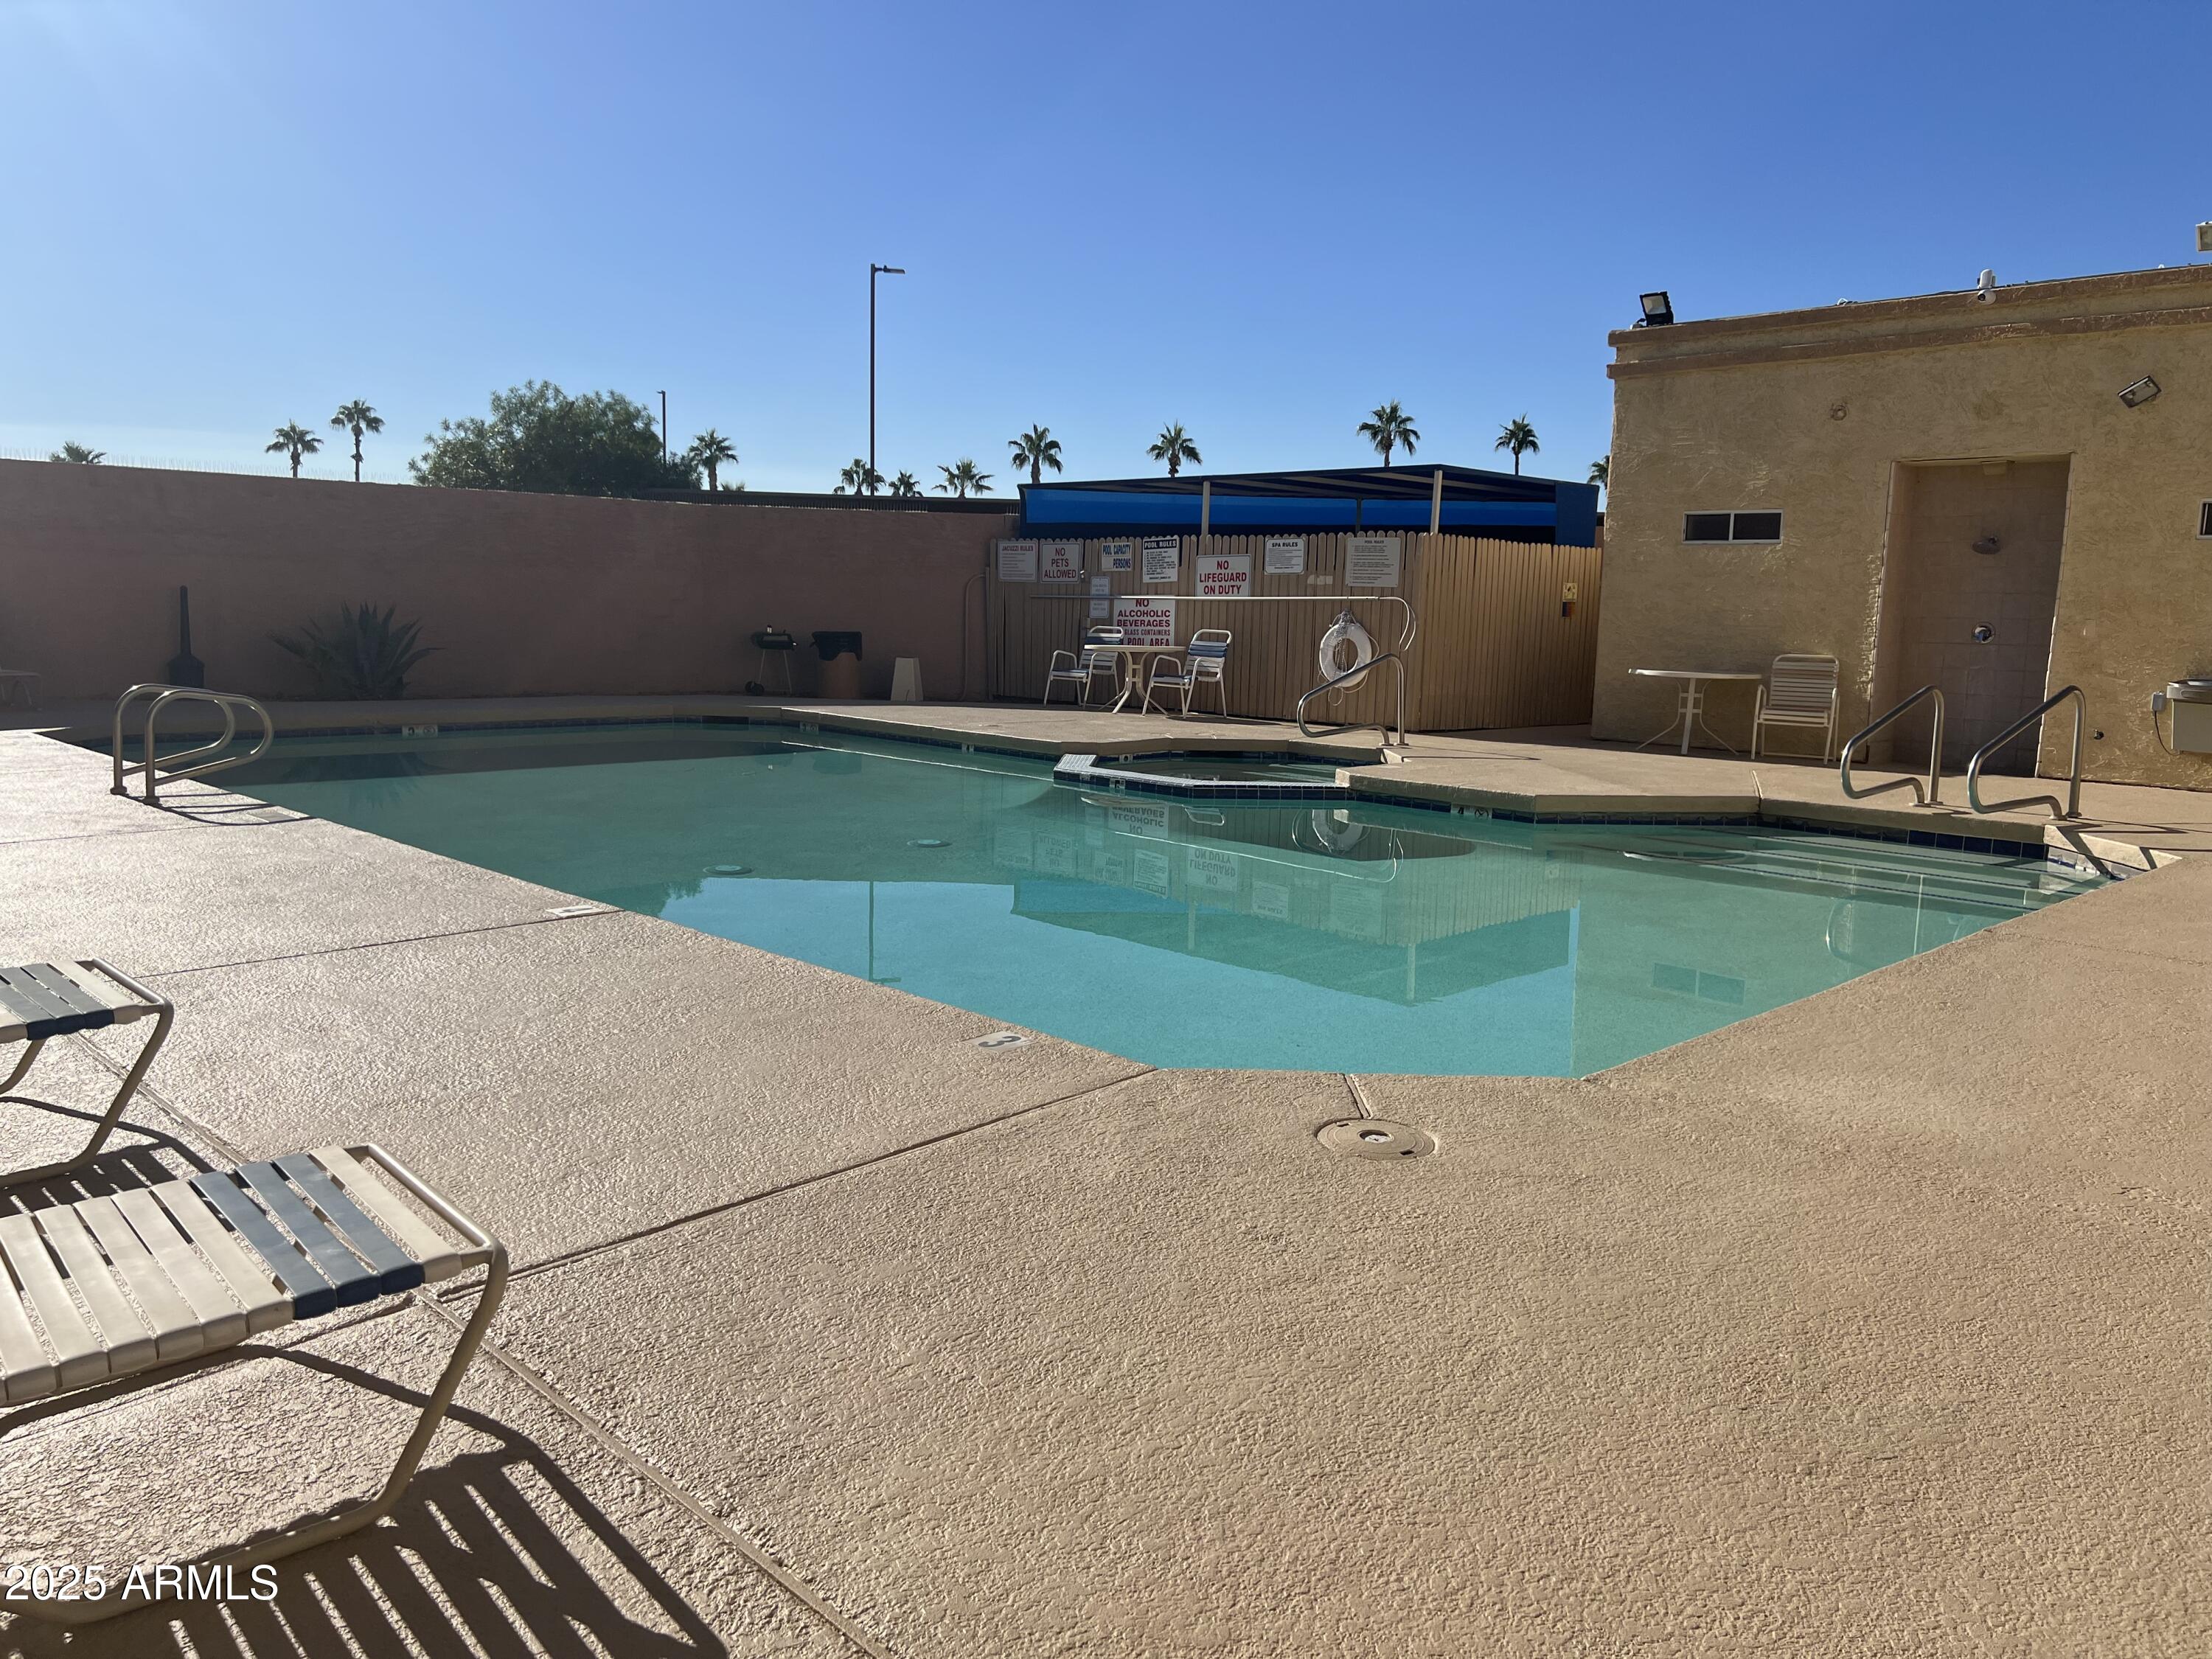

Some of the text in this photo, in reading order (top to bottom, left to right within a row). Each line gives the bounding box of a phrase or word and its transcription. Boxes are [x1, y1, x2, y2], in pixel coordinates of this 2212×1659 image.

[1159, 540, 1177, 548] RULES
[1055, 547, 1066, 557] NO
[1102, 544, 1131, 556] POOL CAPACITY
[1051, 558, 1069, 568] PETS
[1113, 557, 1131, 569] PERSONS
[1217, 560, 1229, 570] NO
[1044, 569, 1077, 579] ALLOWED
[1199, 571, 1247, 583] LIFEGUARD
[1203, 585, 1242, 595] ON DUTY
[1135, 598, 1150, 608] NO
[1117, 609, 1171, 618] ALCOHOLIC
[1116, 619, 1171, 627] BEVERAGES
[1127, 637, 1144, 647] POOL
[1150, 638, 1170, 647] AREA
[978, 1035, 1022, 1048] 3
